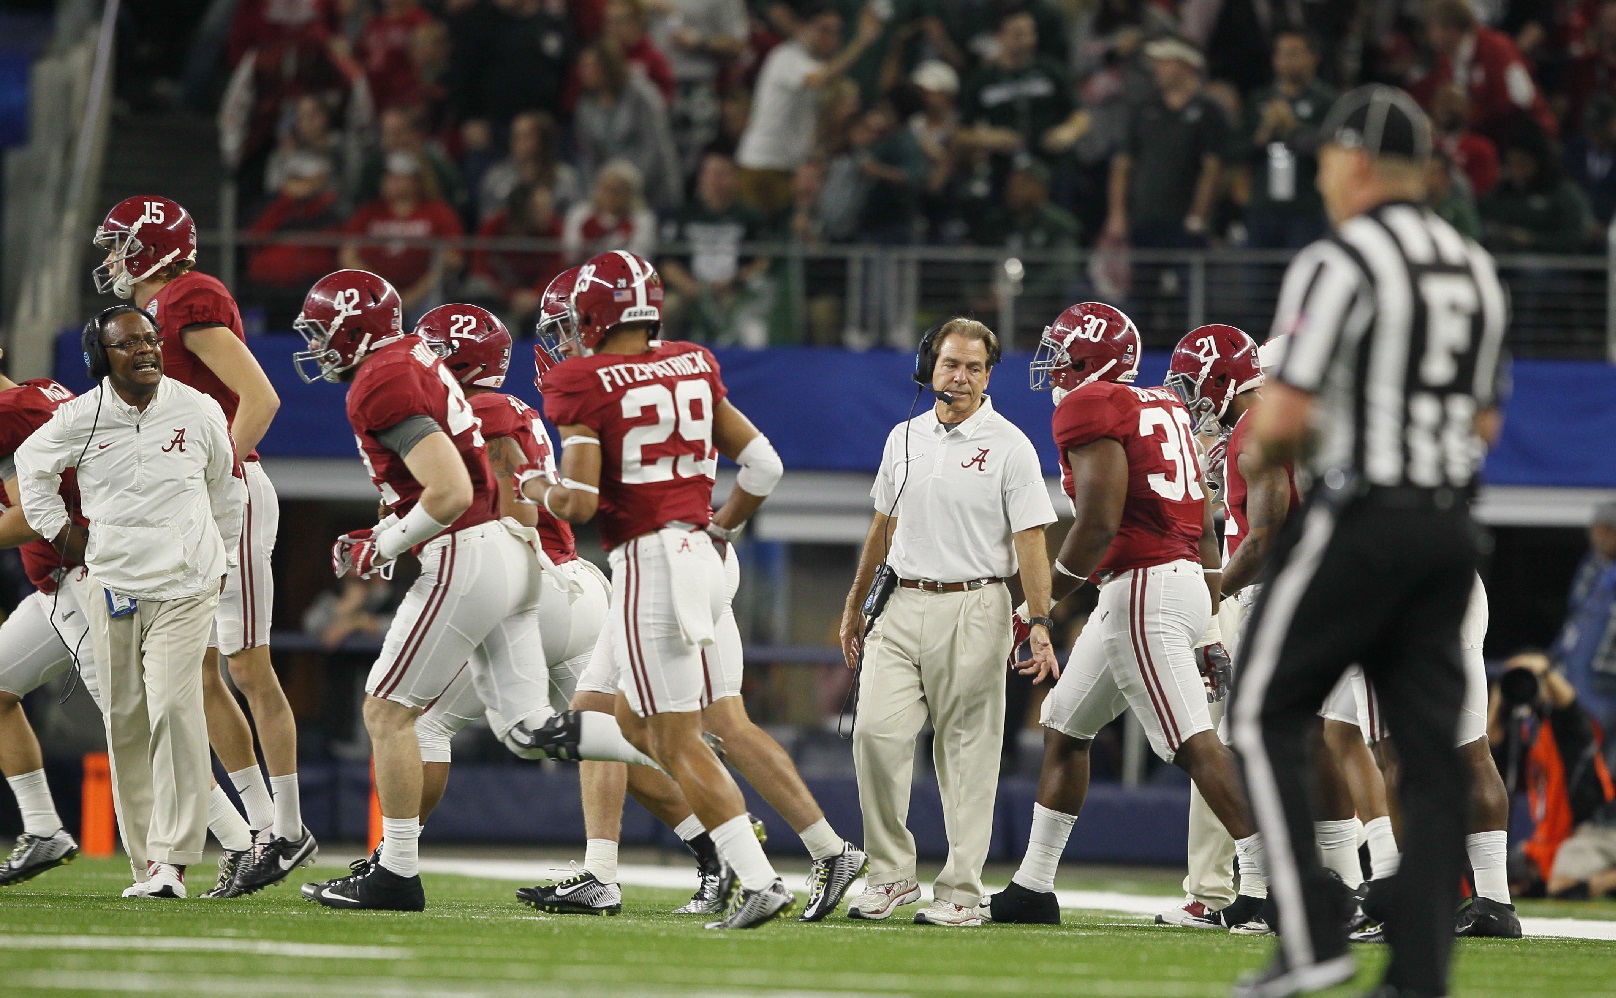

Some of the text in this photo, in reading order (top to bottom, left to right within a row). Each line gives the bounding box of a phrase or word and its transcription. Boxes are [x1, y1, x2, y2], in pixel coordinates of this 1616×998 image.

[143, 201, 165, 224] 15
[333, 288, 362, 317] 42
[450, 314, 477, 339] 22
[1078, 314, 1108, 343] 30
[1195, 335, 1220, 363] 21
[596, 351, 712, 392] FITZPATRICK
[620, 378, 714, 484] 29
[1139, 406, 1205, 501] 30
